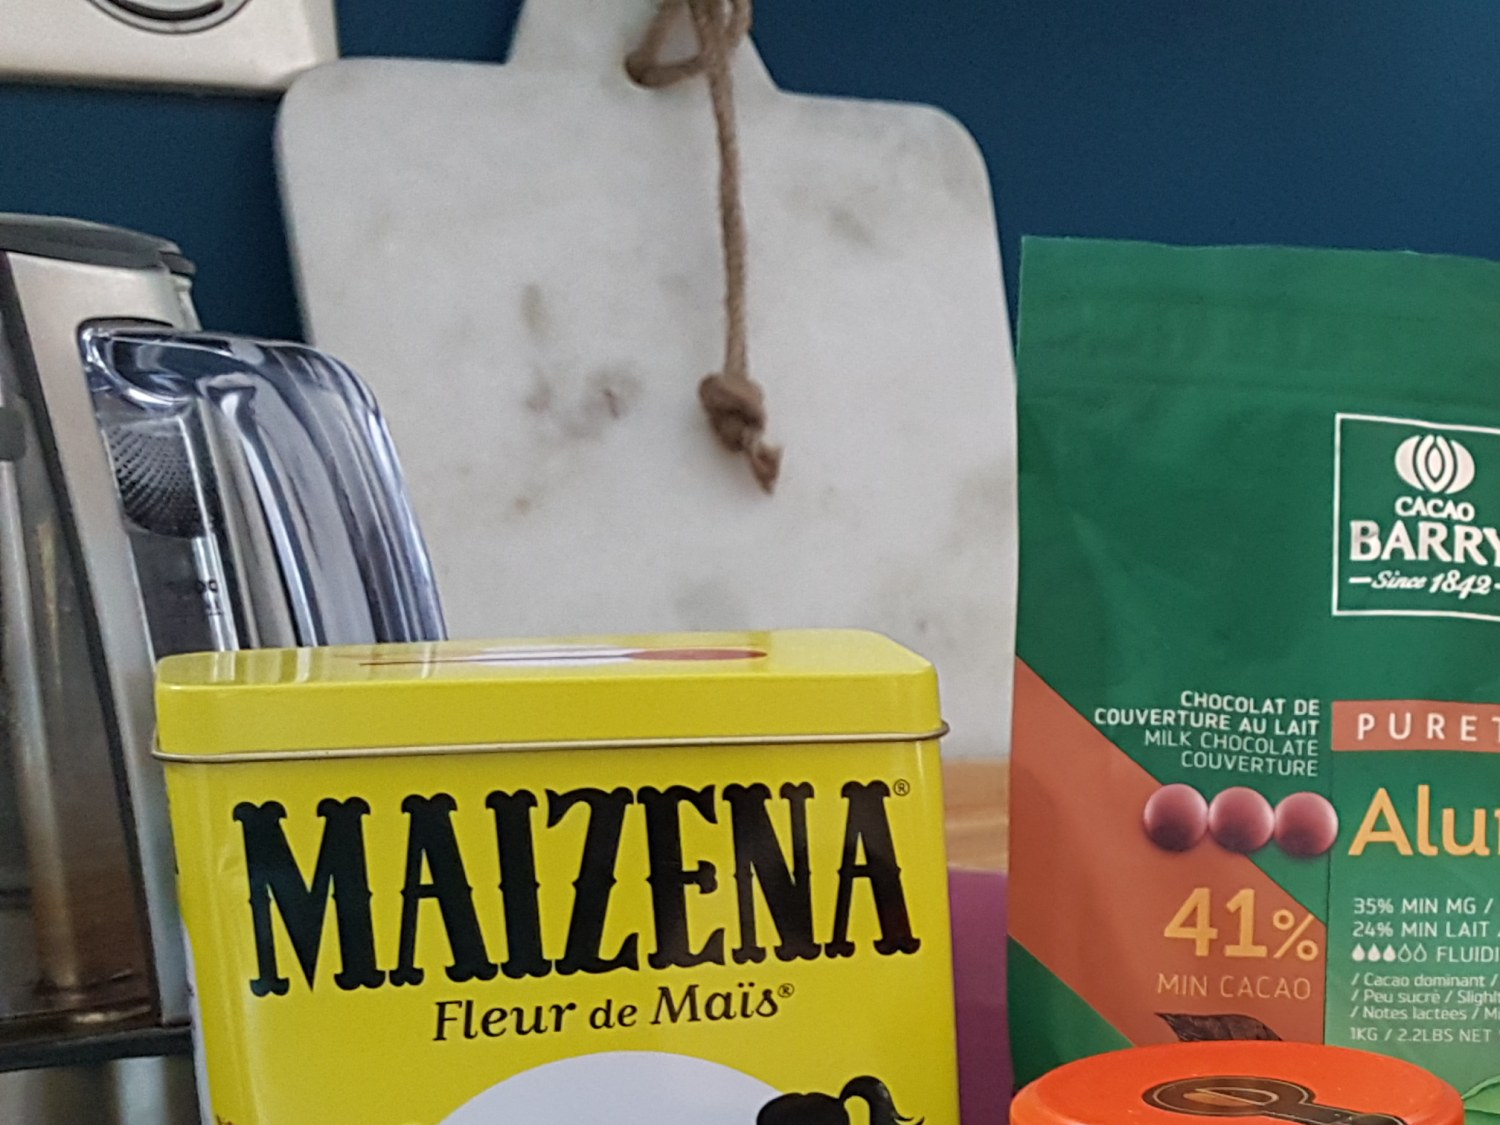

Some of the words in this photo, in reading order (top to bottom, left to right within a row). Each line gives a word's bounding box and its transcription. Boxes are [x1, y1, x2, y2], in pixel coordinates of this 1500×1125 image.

[1395, 496, 1476, 522] CACAO
[1371, 569, 1427, 589] Since
[1429, 569, 1493, 600] 1842
[1180, 690, 1287, 715] CHOCOLAT
[1294, 699, 1320, 717] DE
[1094, 708, 1231, 731] COUVERTURE
[1238, 717, 1267, 735] AU
[1274, 718, 1320, 736] LAIT
[1144, 729, 1192, 747] MILK
[1200, 731, 1319, 757] CHOCOLATE
[1181, 750, 1319, 777] COUVERTURE
[233, 780, 922, 997] MAIZENA
[1353, 898, 1394, 915] 35%
[1401, 898, 1439, 915] MIN
[1446, 898, 1477, 915] MG
[1162, 887, 1319, 962] 41%
[1352, 921, 1394, 938] 24%
[1401, 921, 1439, 938] MIN
[1446, 921, 1491, 938] LAIT
[1156, 972, 1210, 998] MIN
[1219, 975, 1312, 1001] CACAO
[1363, 972, 1410, 988] Cacao
[1414, 973, 1486, 988] dominant
[1363, 988, 1394, 1004] Peu
[433, 999, 577, 1043] Fleur
[590, 997, 639, 1029] de
[650, 981, 779, 1026] Maïs
[1362, 1005, 1408, 1020] Notes
[1350, 1027, 1379, 1042] 1KG
[1397, 1027, 1454, 1042] 2.2LBS
[1459, 1028, 1493, 1043] NET
